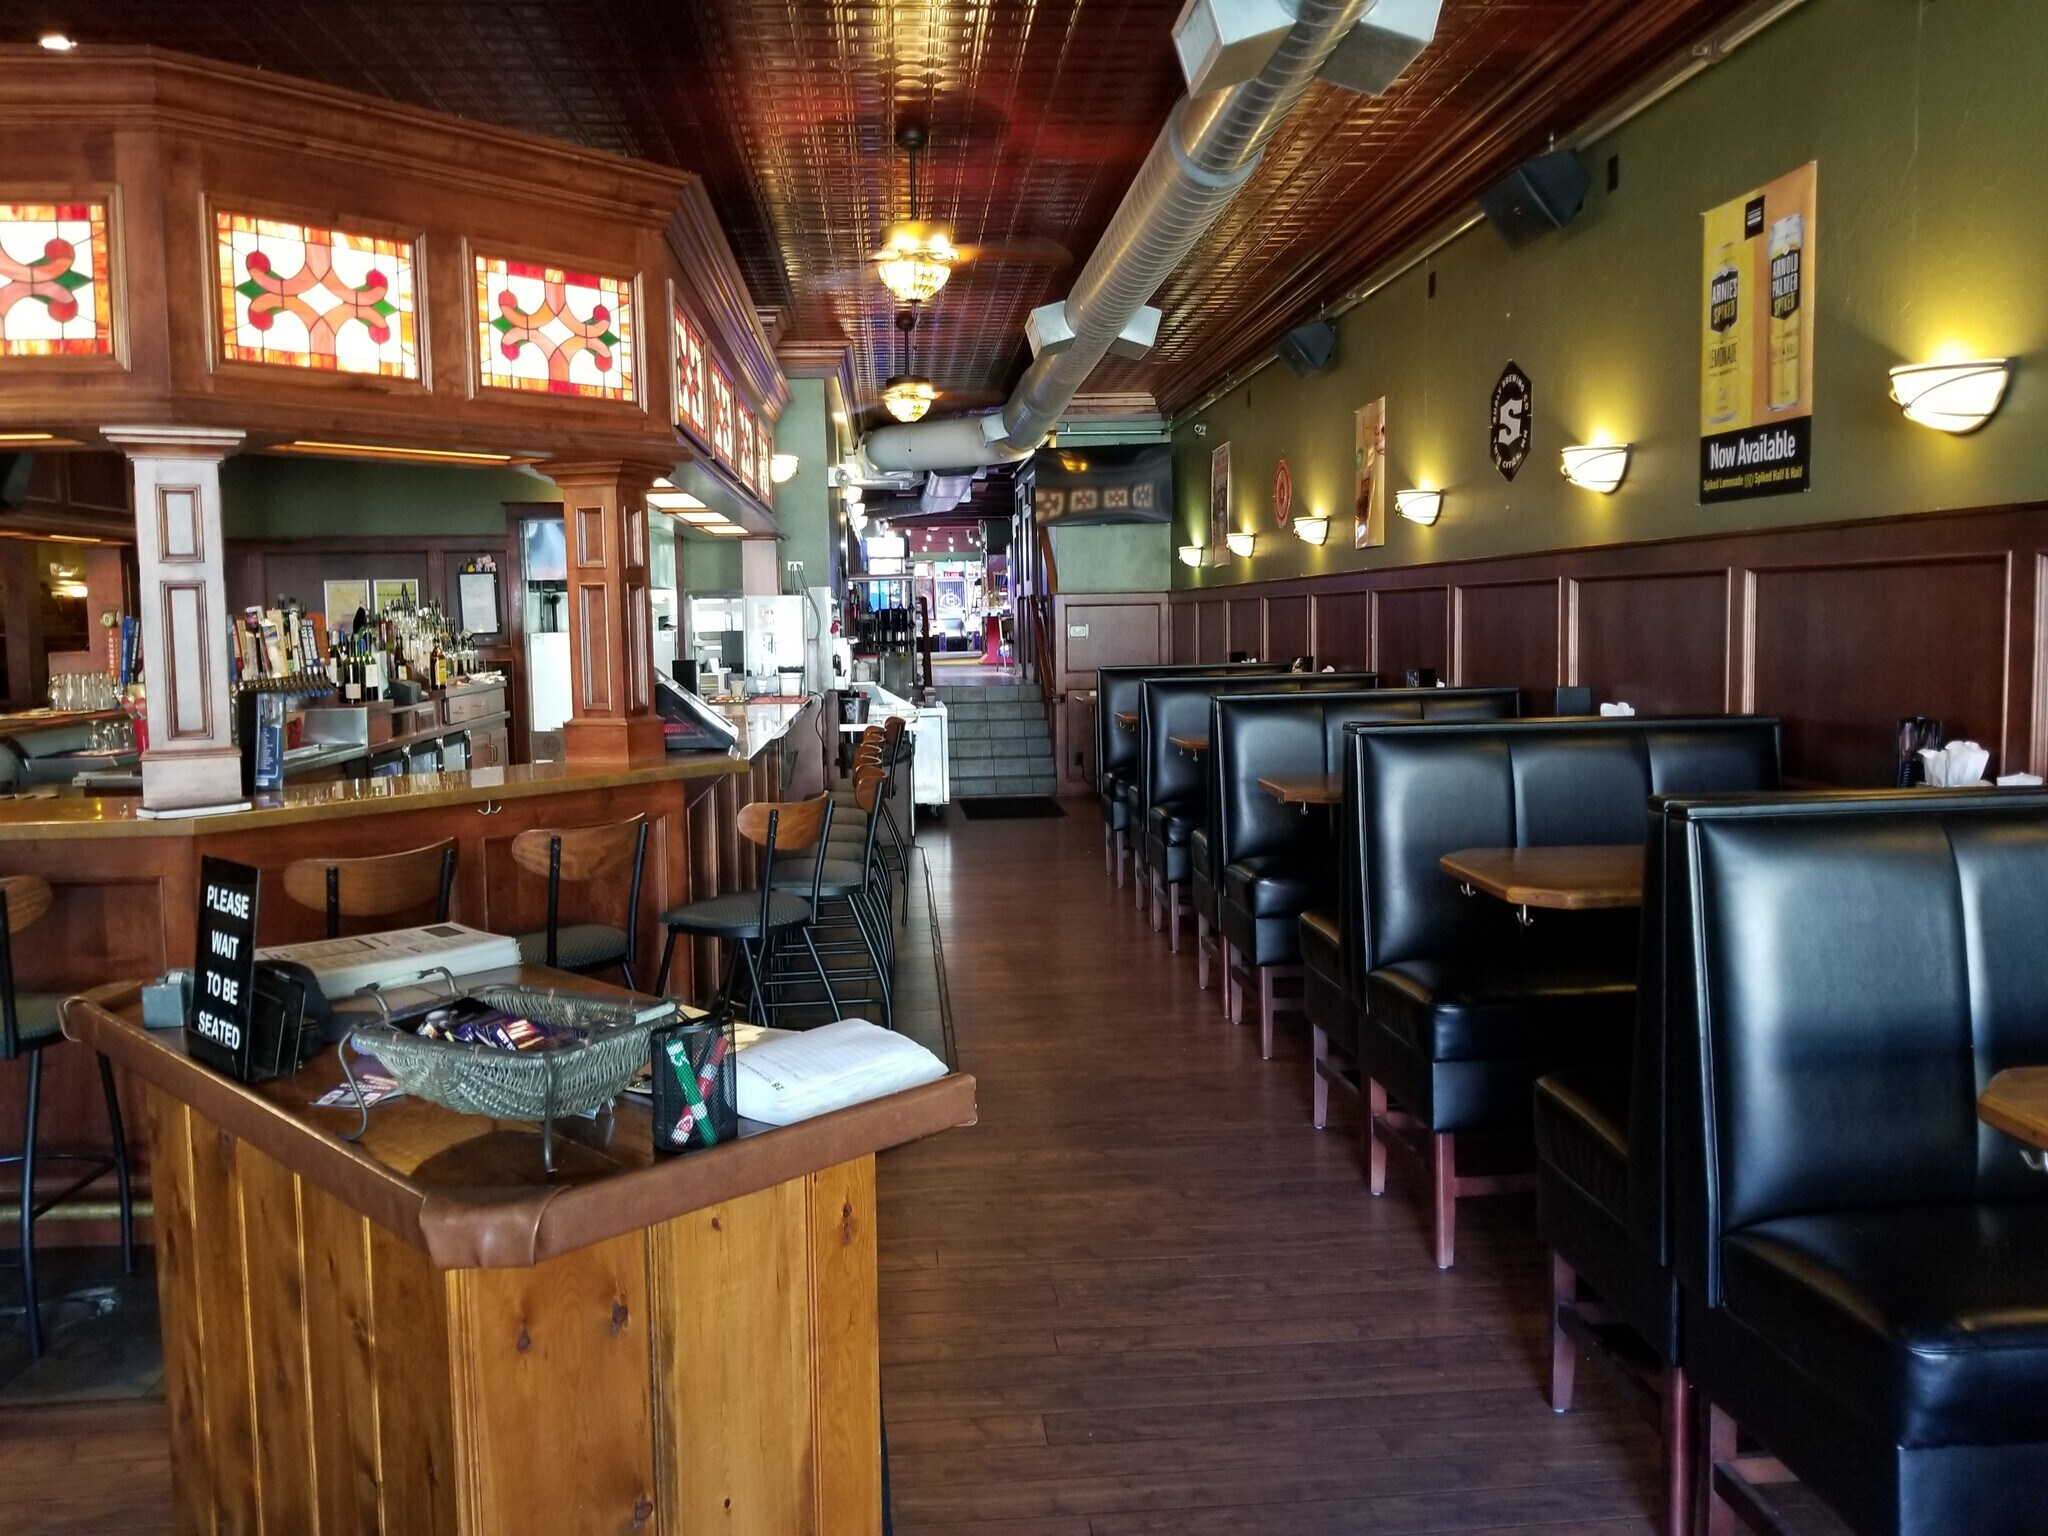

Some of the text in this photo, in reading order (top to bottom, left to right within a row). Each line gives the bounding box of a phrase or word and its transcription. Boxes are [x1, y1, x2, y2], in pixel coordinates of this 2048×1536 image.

[1773, 253, 1798, 280] ARNOLD
[1712, 278, 1737, 306] ARNIES
[1772, 272, 1798, 299] PALMER
[1714, 299, 1736, 324] SPIKED
[1774, 291, 1795, 317] SPIKED
[1709, 342, 1737, 368] LEMONADE
[1502, 374, 1524, 392] BREWING
[1523, 394, 1529, 411] CO
[1498, 398, 1523, 446] S
[1710, 429, 1796, 470] Now Available
[1754, 470, 1772, 485] Spiked
[1772, 467, 1785, 482] Half
[1784, 467, 1790, 480] &
[1790, 465, 1803, 479] Half
[206, 884, 250, 920] PLEASE
[211, 929, 239, 961] WAIT
[206, 970, 239, 1006] TO BE
[198, 1010, 241, 1050] SEATED
[771, 1081, 785, 1092] 28
